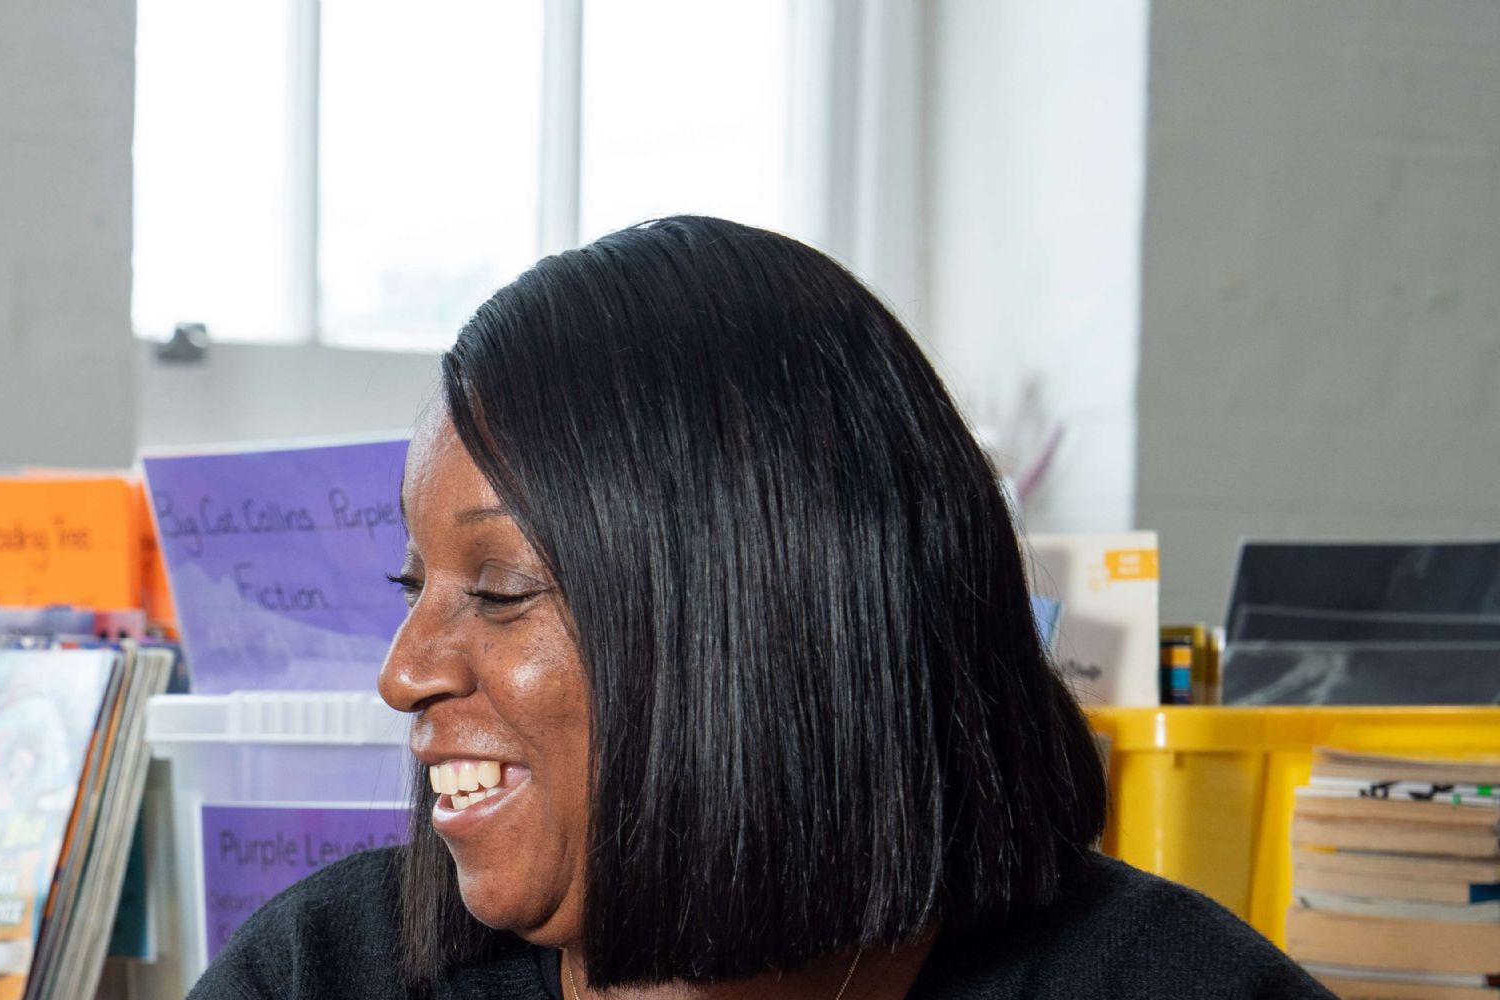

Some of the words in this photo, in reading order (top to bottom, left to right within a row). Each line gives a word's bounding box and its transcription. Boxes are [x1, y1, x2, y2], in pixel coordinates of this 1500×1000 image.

[153, 490, 203, 558] Big
[200, 495, 239, 535] Cat
[242, 497, 315, 533] Collins
[329, 488, 397, 540] Purple
[233, 561, 331, 611] Fiction
[219, 829, 298, 872] Purple
